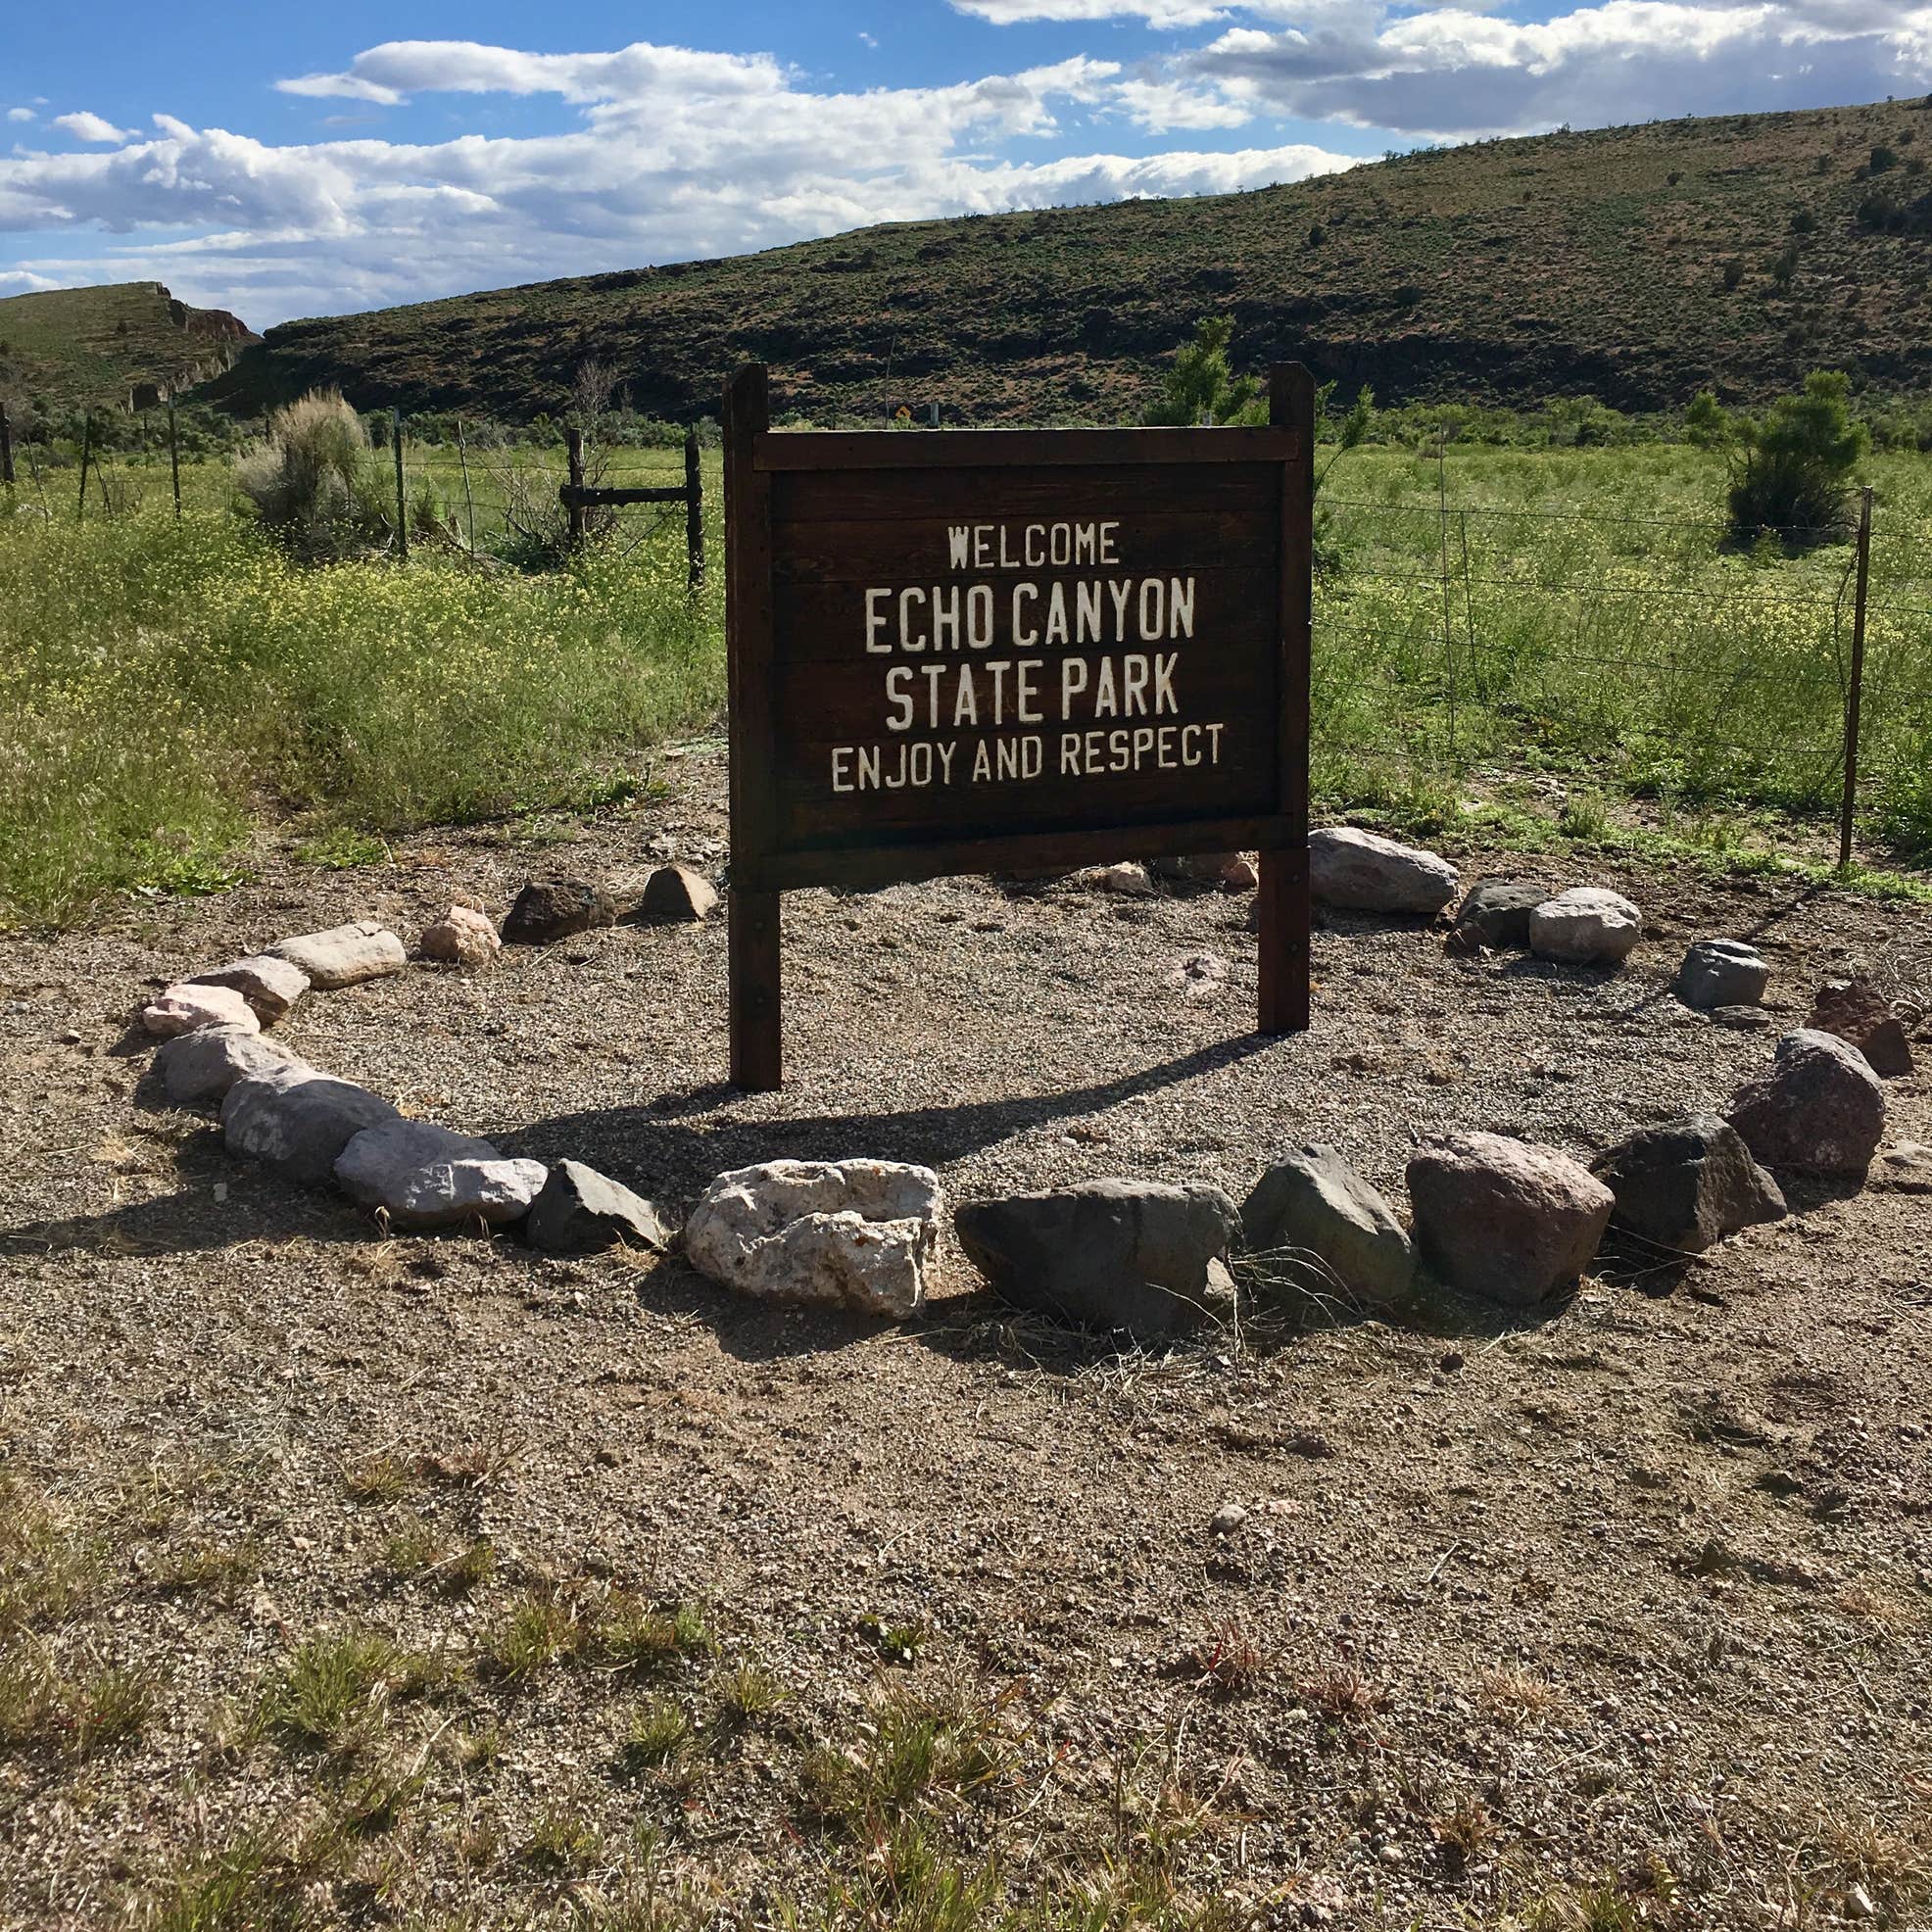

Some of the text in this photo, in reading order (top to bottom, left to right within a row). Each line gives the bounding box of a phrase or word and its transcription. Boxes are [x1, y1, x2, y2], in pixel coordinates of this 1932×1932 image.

[947, 521, 1121, 569] WELCOME
[865, 577, 1196, 653] ECHO CANYON
[886, 652, 1180, 731] STATE PARK
[832, 723, 1225, 793] ENJOY AND RESPECT
